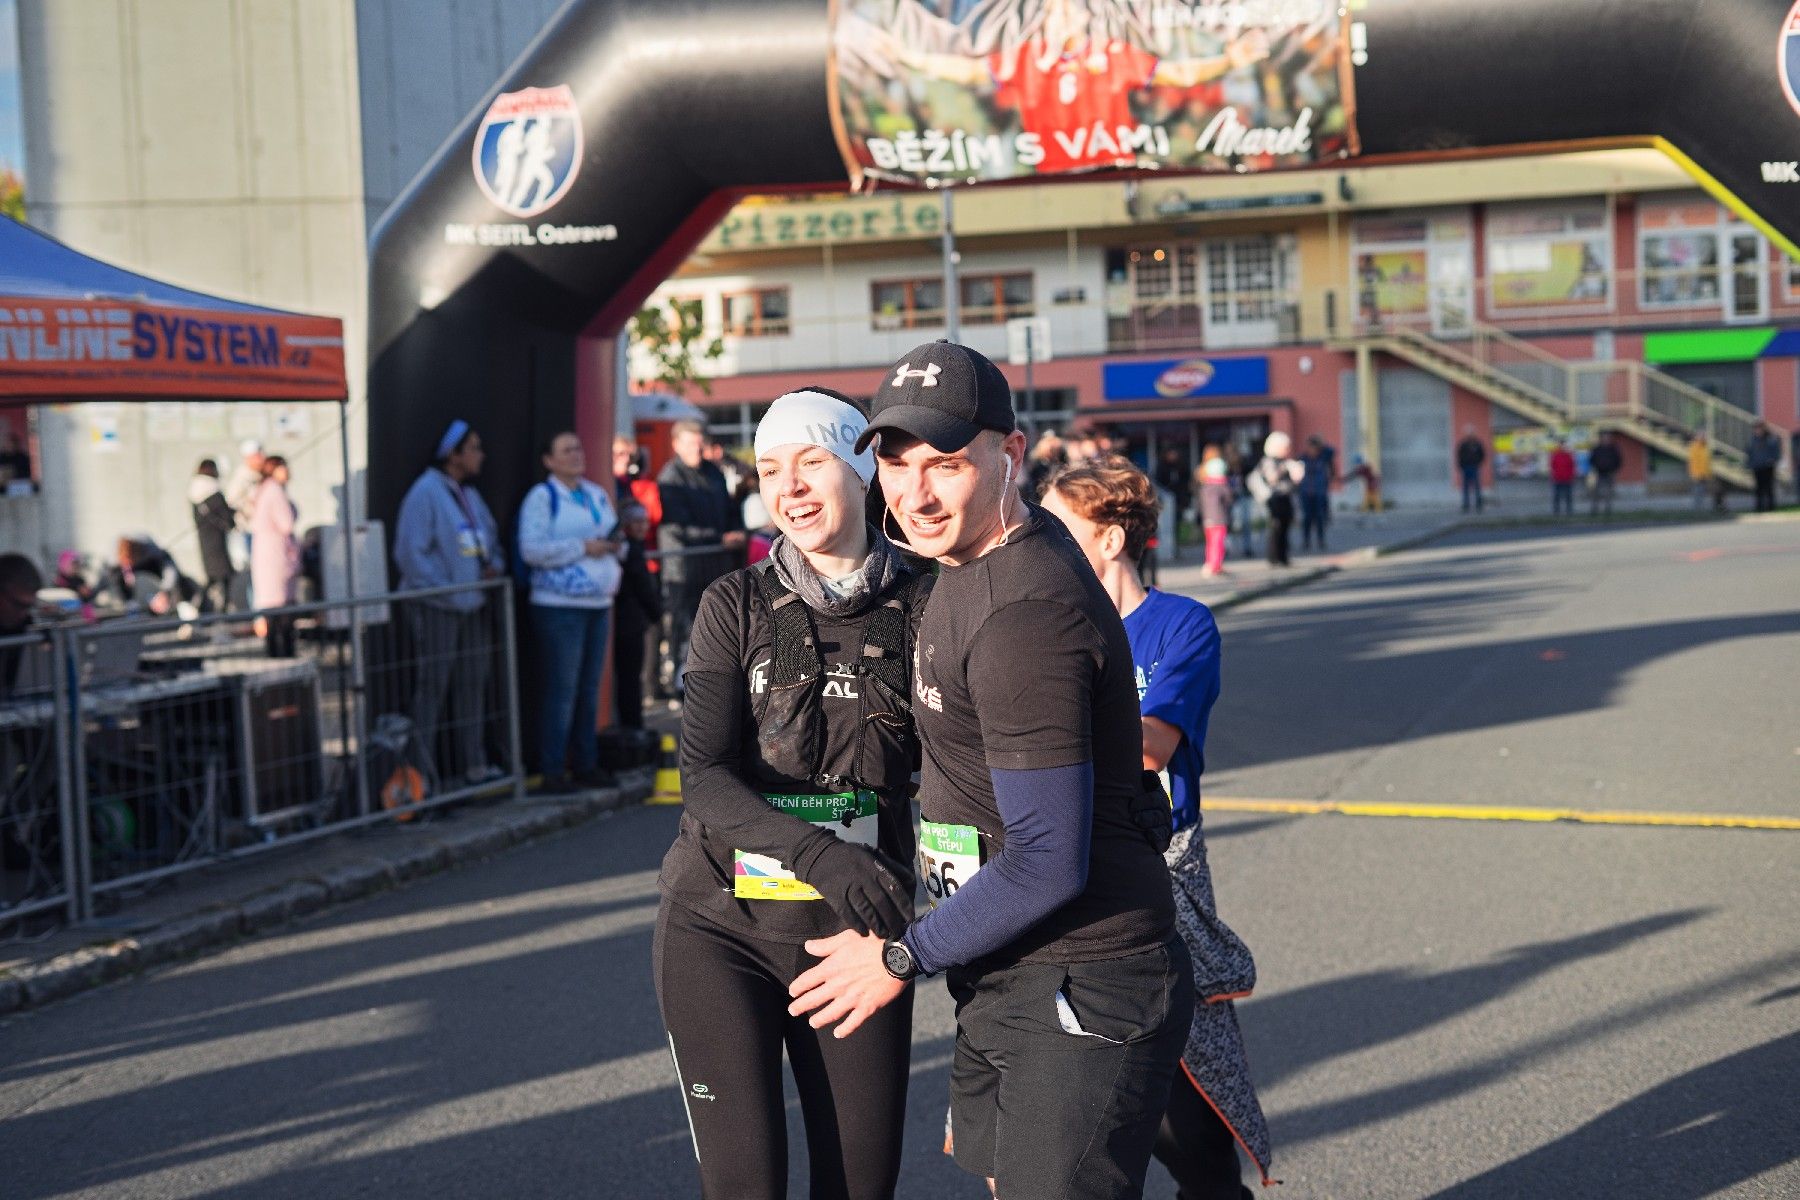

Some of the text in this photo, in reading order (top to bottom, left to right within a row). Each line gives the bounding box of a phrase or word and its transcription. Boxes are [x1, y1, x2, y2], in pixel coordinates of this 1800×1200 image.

[865, 120, 1170, 172] BĚŽÍM S VÁMI
[1196, 105, 1313, 156] Marek
[537, 223, 618, 244] Ostrava
[720, 199, 939, 245] Pizzerie
[802, 797, 823, 808] BĚH
[826, 797, 848, 808] PRO
